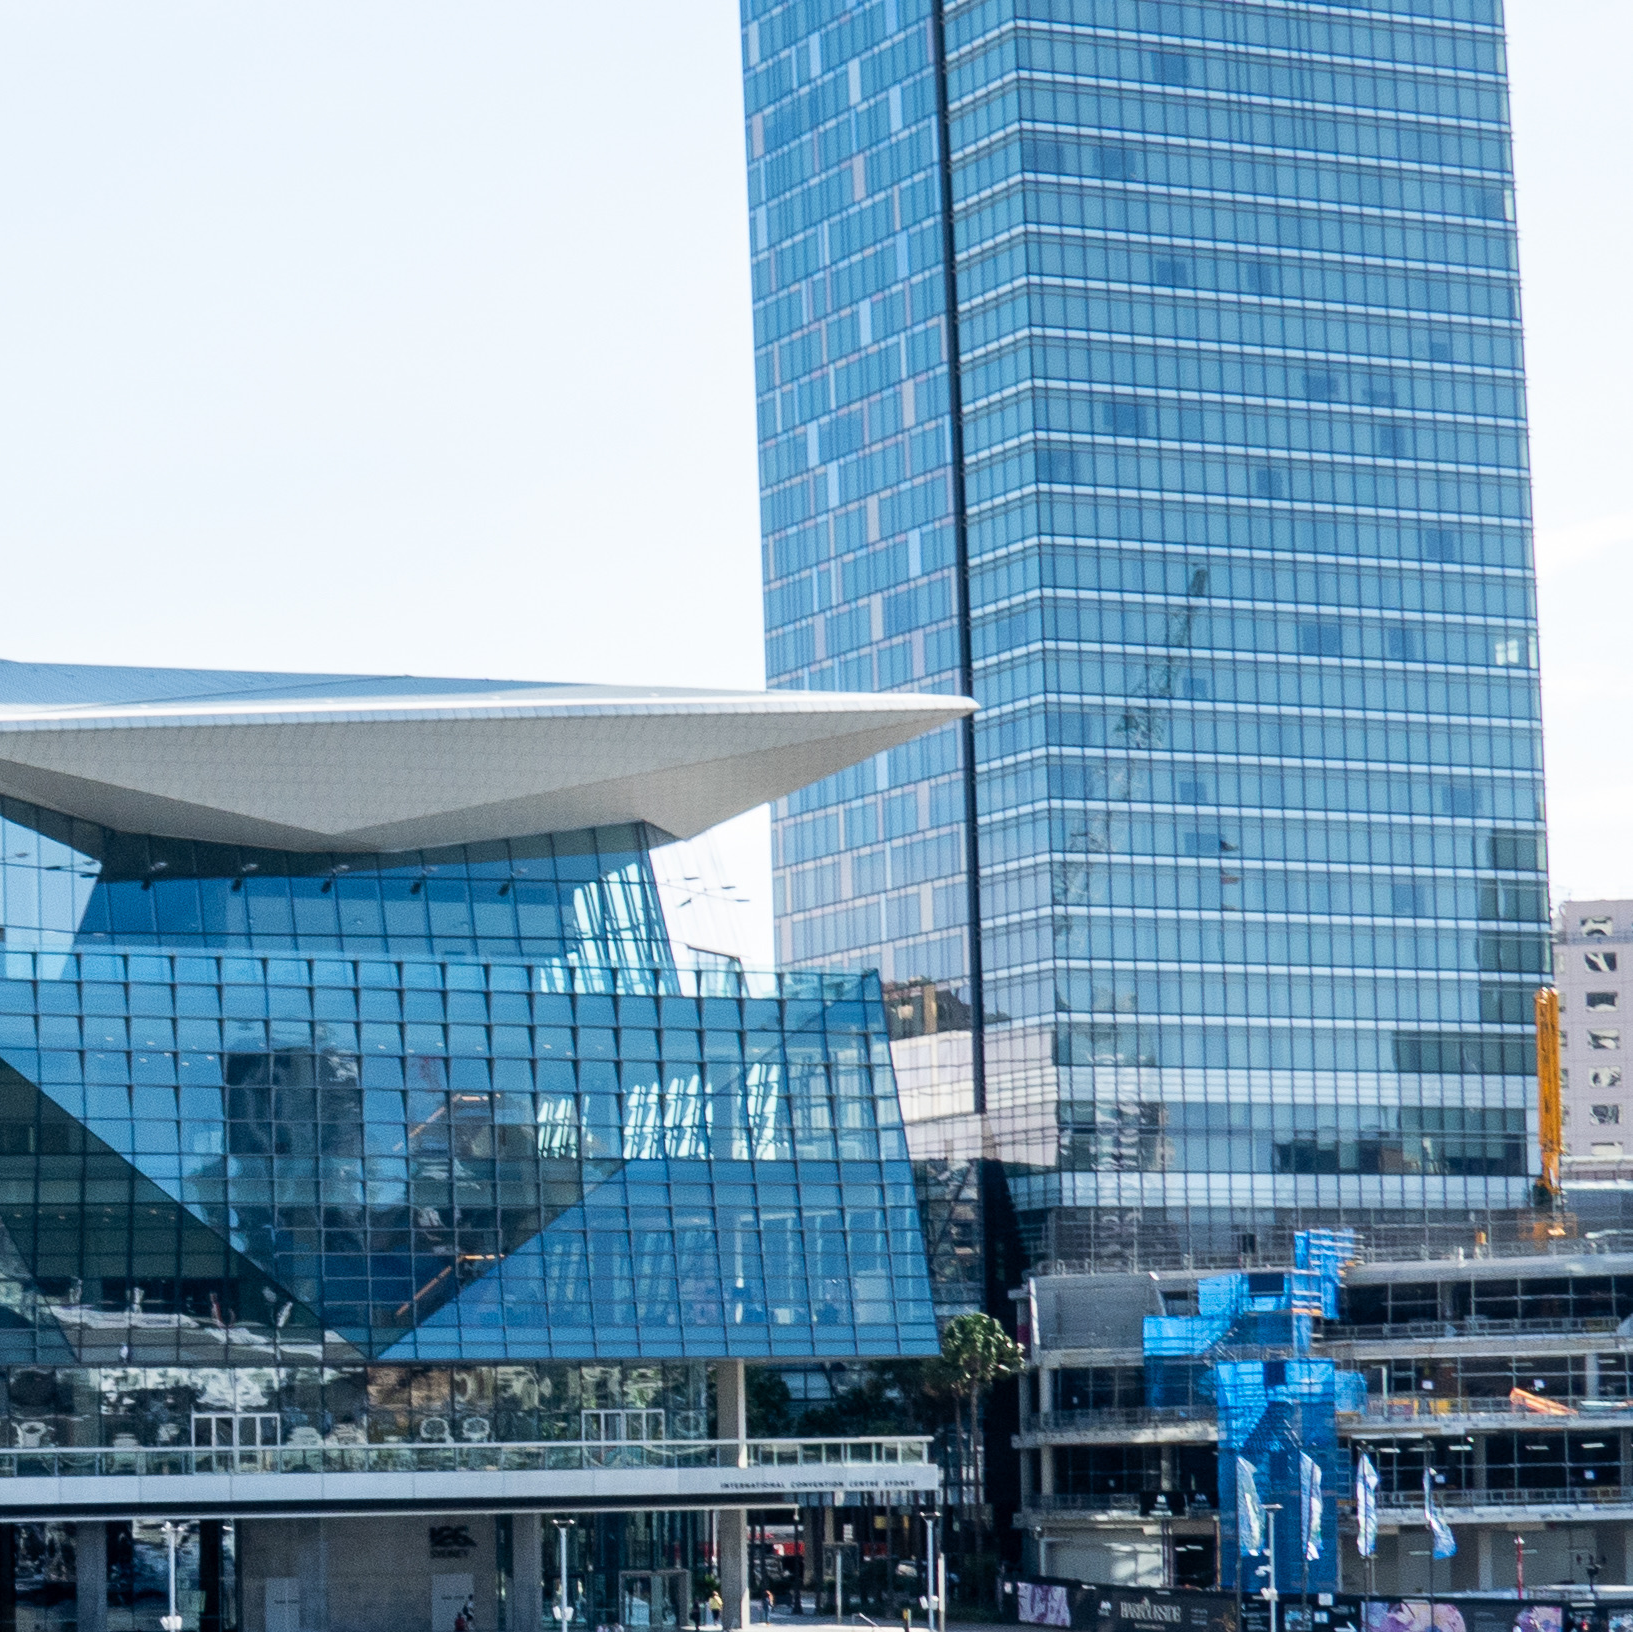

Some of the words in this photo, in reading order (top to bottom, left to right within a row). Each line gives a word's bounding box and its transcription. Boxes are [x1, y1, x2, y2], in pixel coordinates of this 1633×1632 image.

[790, 1480, 844, 1489] CONVENTION
[849, 1480, 879, 1488] CENTRE
[885, 1479, 916, 1487] SYDNEY
